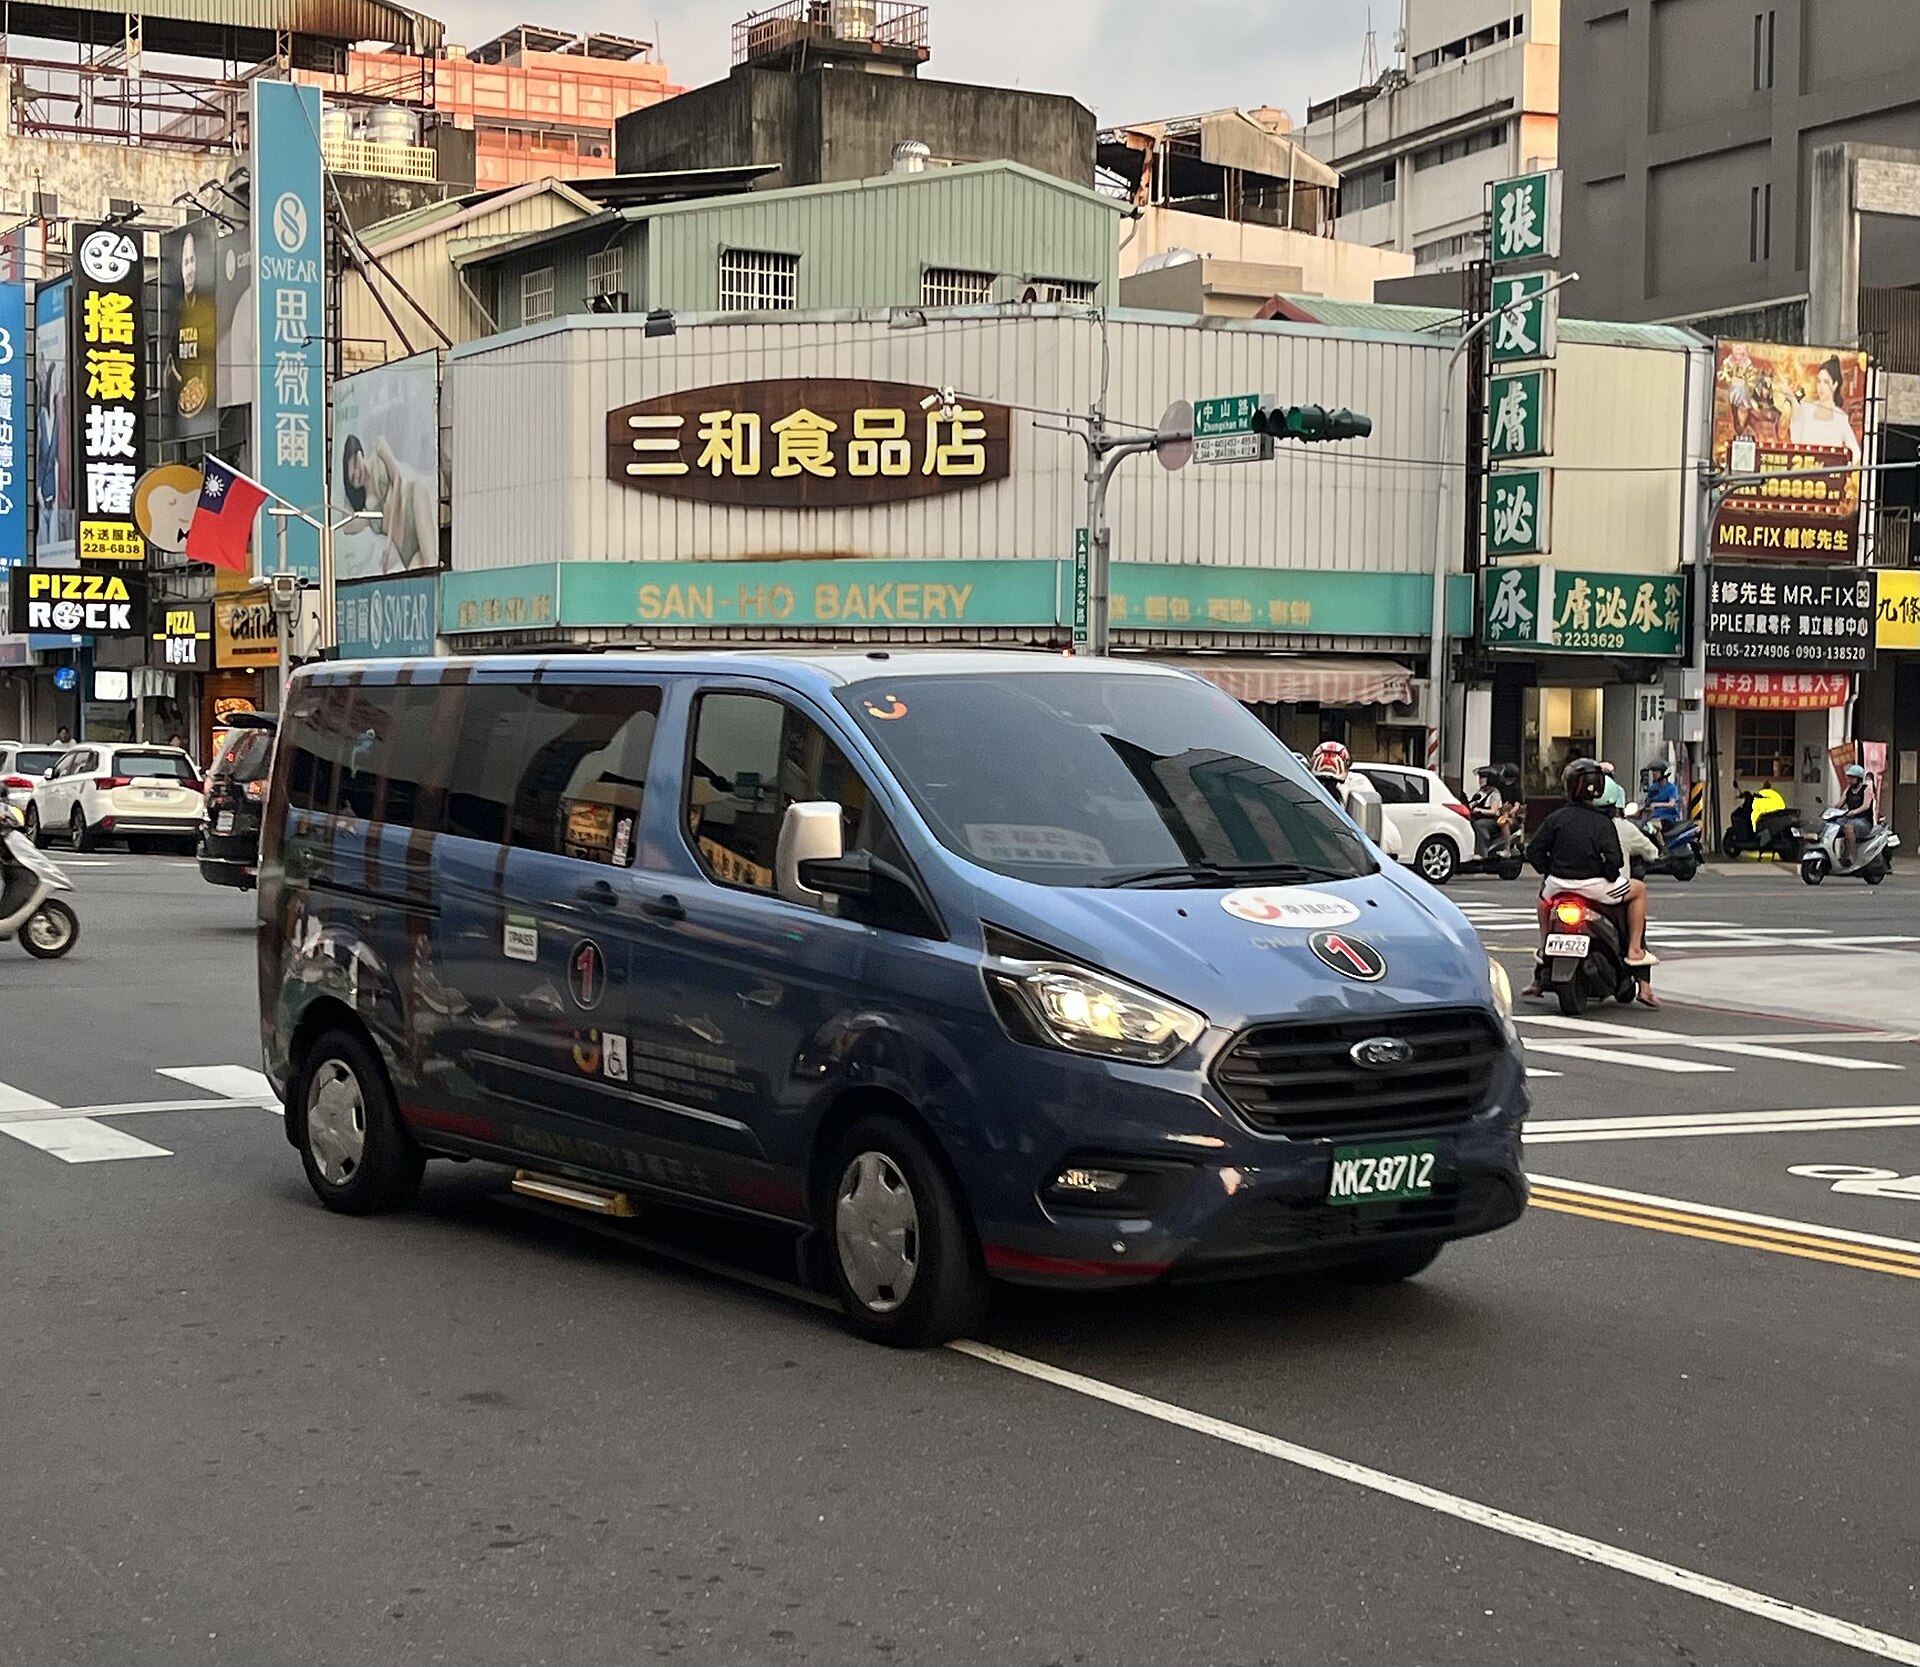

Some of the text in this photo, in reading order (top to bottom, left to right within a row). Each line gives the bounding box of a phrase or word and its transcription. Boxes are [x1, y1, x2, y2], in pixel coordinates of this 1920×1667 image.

[261, 255, 320, 284] SWEAR
[274, 288, 310, 467] 思薇爾
[1203, 398, 1248, 420] 中山路
[626, 408, 987, 477] 三和食品店
[83, 528, 141, 542] 外送服務
[84, 542, 140, 555] 228-6838
[1719, 524, 1848, 551] MR.FIX 維修先生
[29, 573, 130, 600] PIZZA
[1783, 585, 1855, 606] MR.FIX
[638, 583, 974, 621] SAN-HO BAKERY
[1552, 578, 1663, 633] 膚泌尿
[166, 611, 195, 635] PIZZA
[383, 592, 430, 644] SWEAR
[1565, 632, 1624, 648] 2233629
[1324, 934, 1374, 974] 1
[577, 945, 595, 1003] 1
[1330, 1152, 1436, 1197] KKZ-8712
